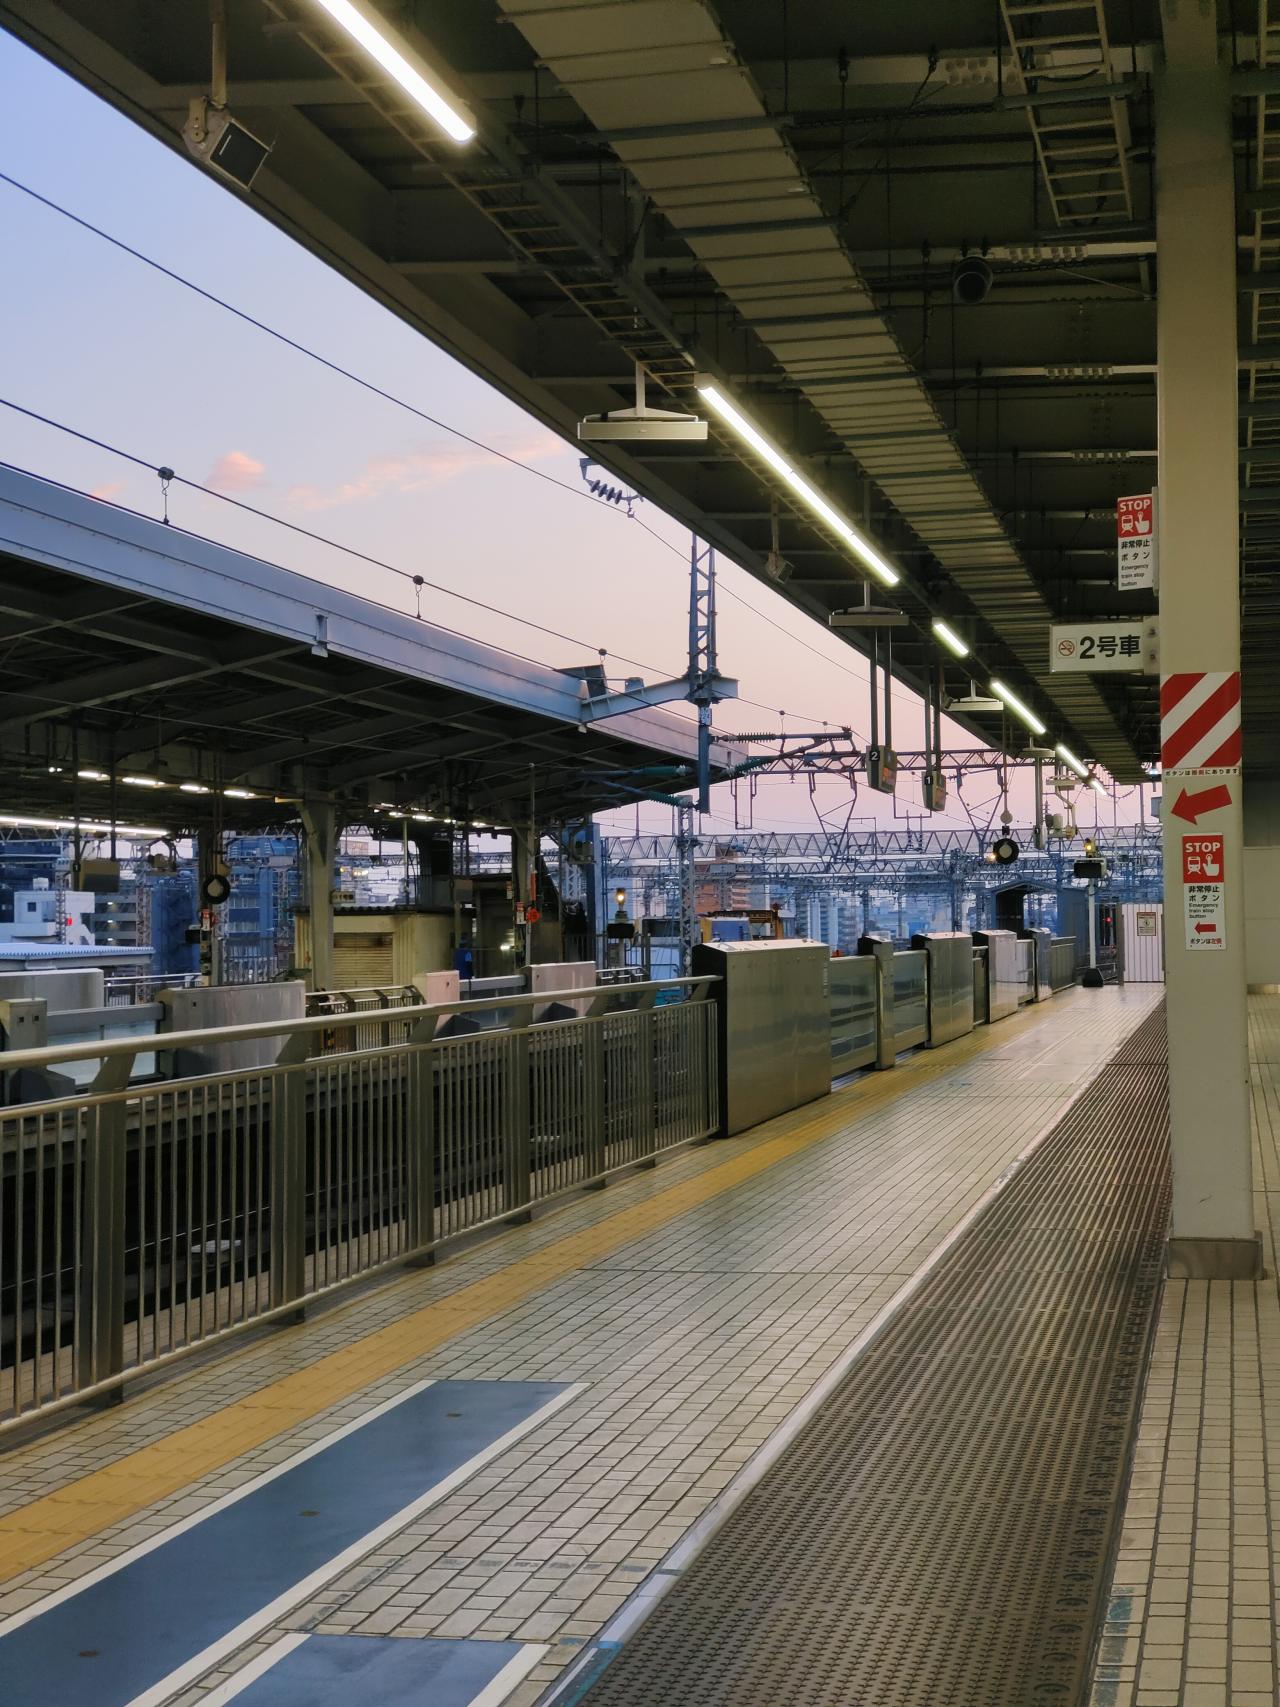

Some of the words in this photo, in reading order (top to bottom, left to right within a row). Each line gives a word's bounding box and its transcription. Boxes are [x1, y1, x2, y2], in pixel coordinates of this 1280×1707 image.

[1120, 499, 1150, 512] STOP
[1121, 539, 1150, 549] 非常停止
[1121, 552, 1150, 561] ボタン
[1121, 563, 1149, 571] Emergency
[1133, 571, 1144, 579] stop
[1079, 634, 1141, 659] 2号車
[871, 751, 878, 760] 2
[926, 776, 931, 784] 1
[1185, 842, 1221, 853] STOP
[1188, 885, 1220, 893] 非常停止
[1188, 894, 1220, 902] ボタン
